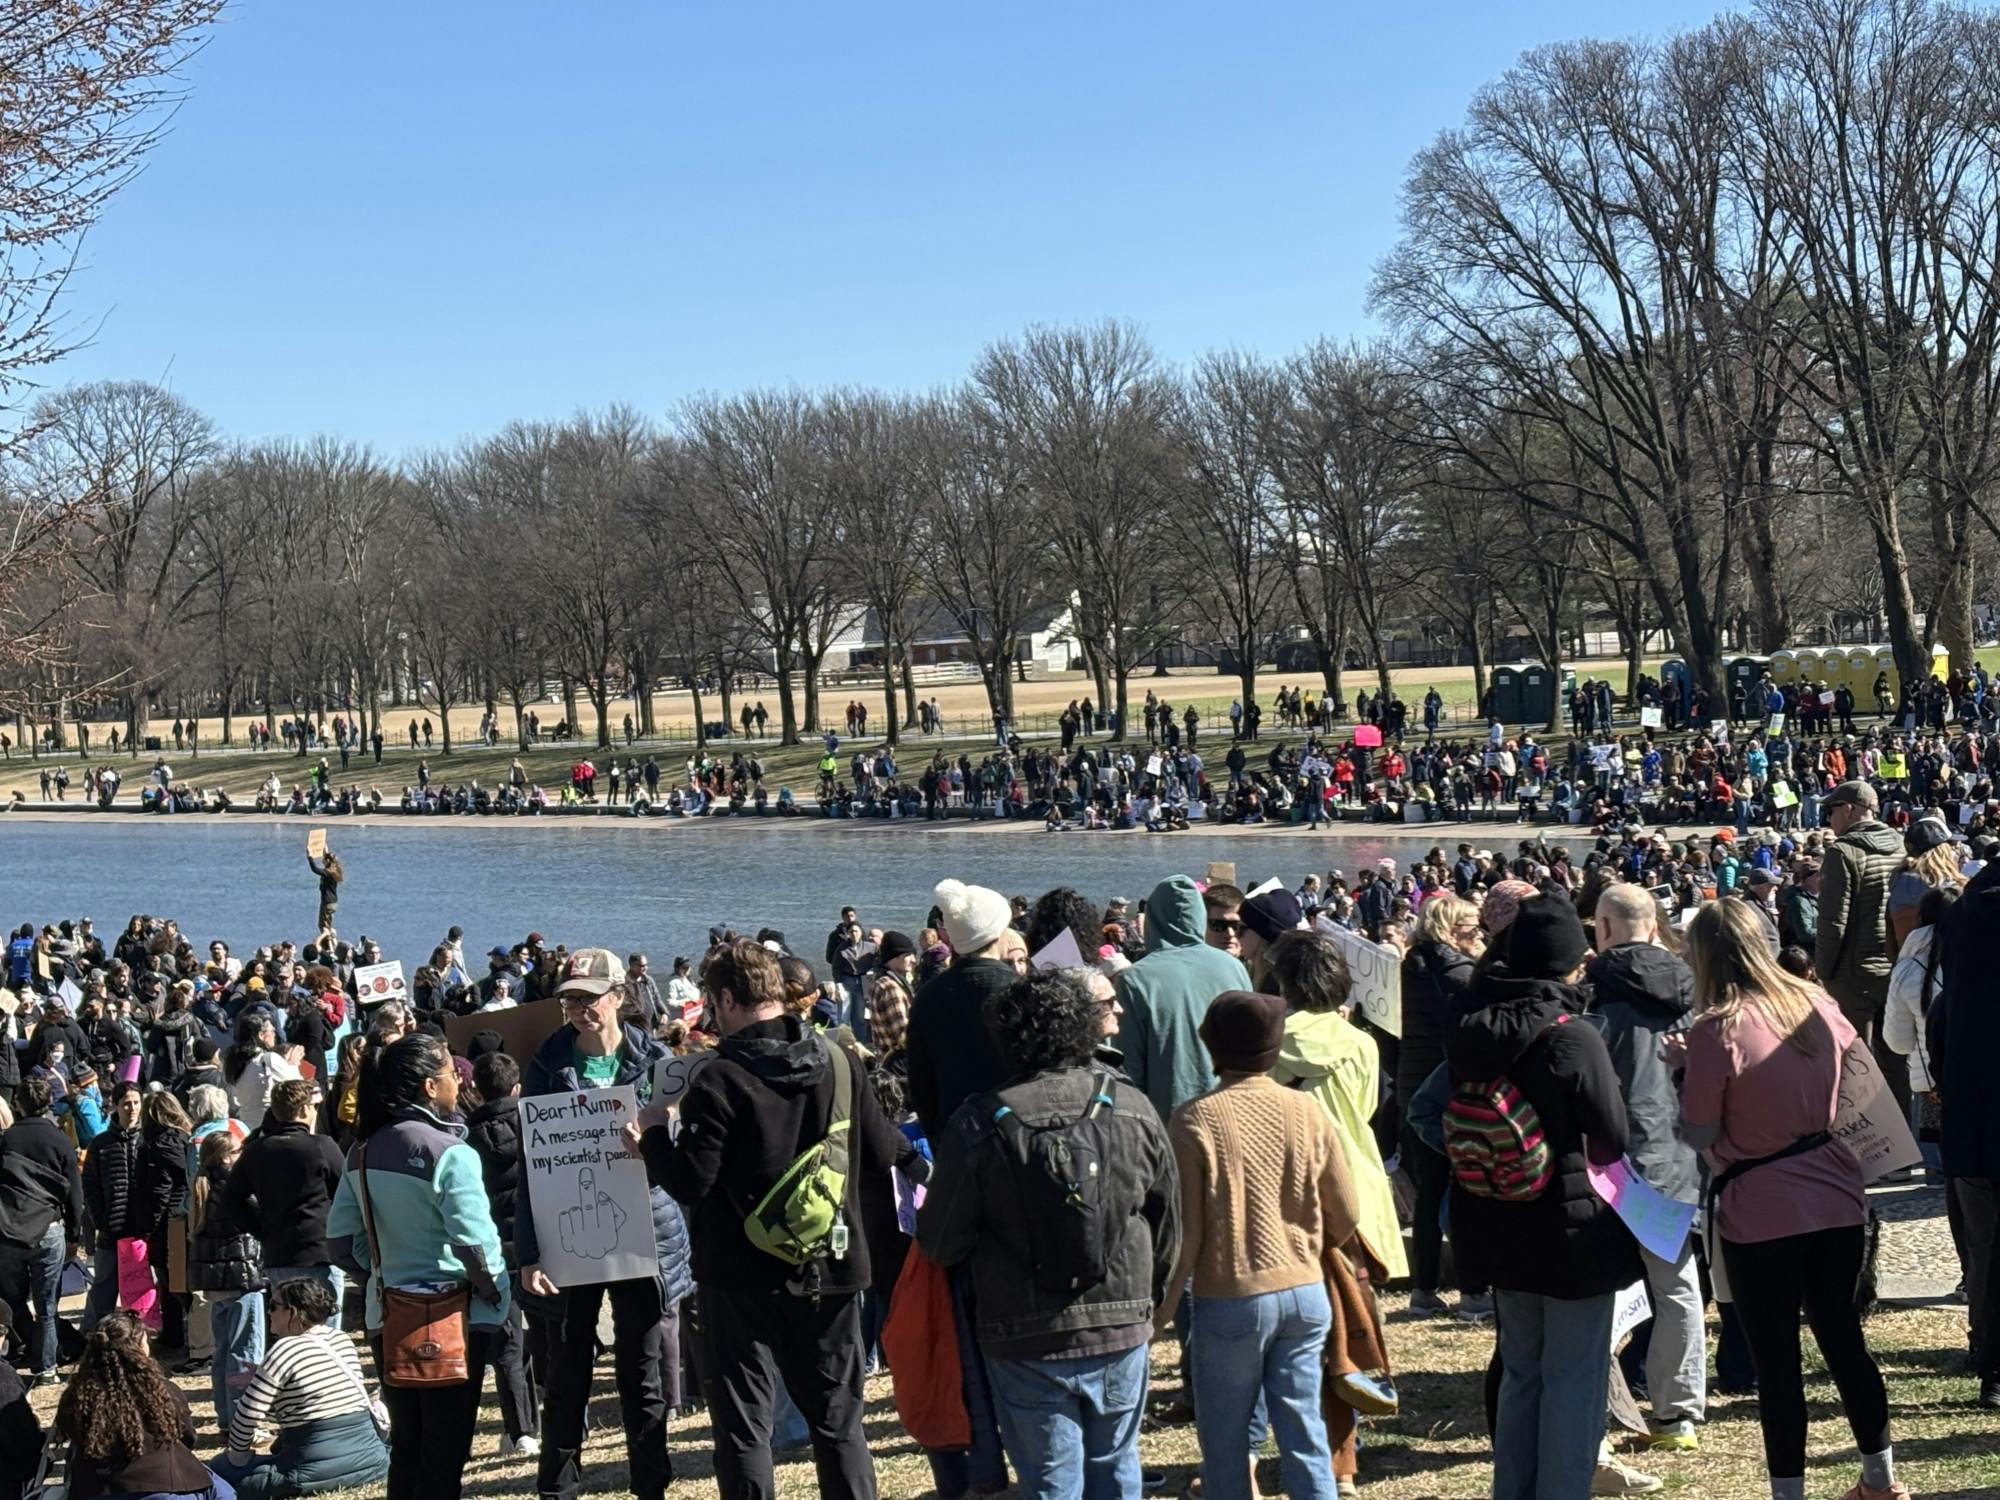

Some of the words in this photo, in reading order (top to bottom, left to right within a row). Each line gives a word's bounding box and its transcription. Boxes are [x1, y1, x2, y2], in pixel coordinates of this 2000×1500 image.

[525, 1102, 567, 1124] Dear
[531, 1128, 547, 1148] A
[549, 1127, 607, 1145] message
[532, 1156, 552, 1175] my
[555, 1148, 602, 1167] scientist
